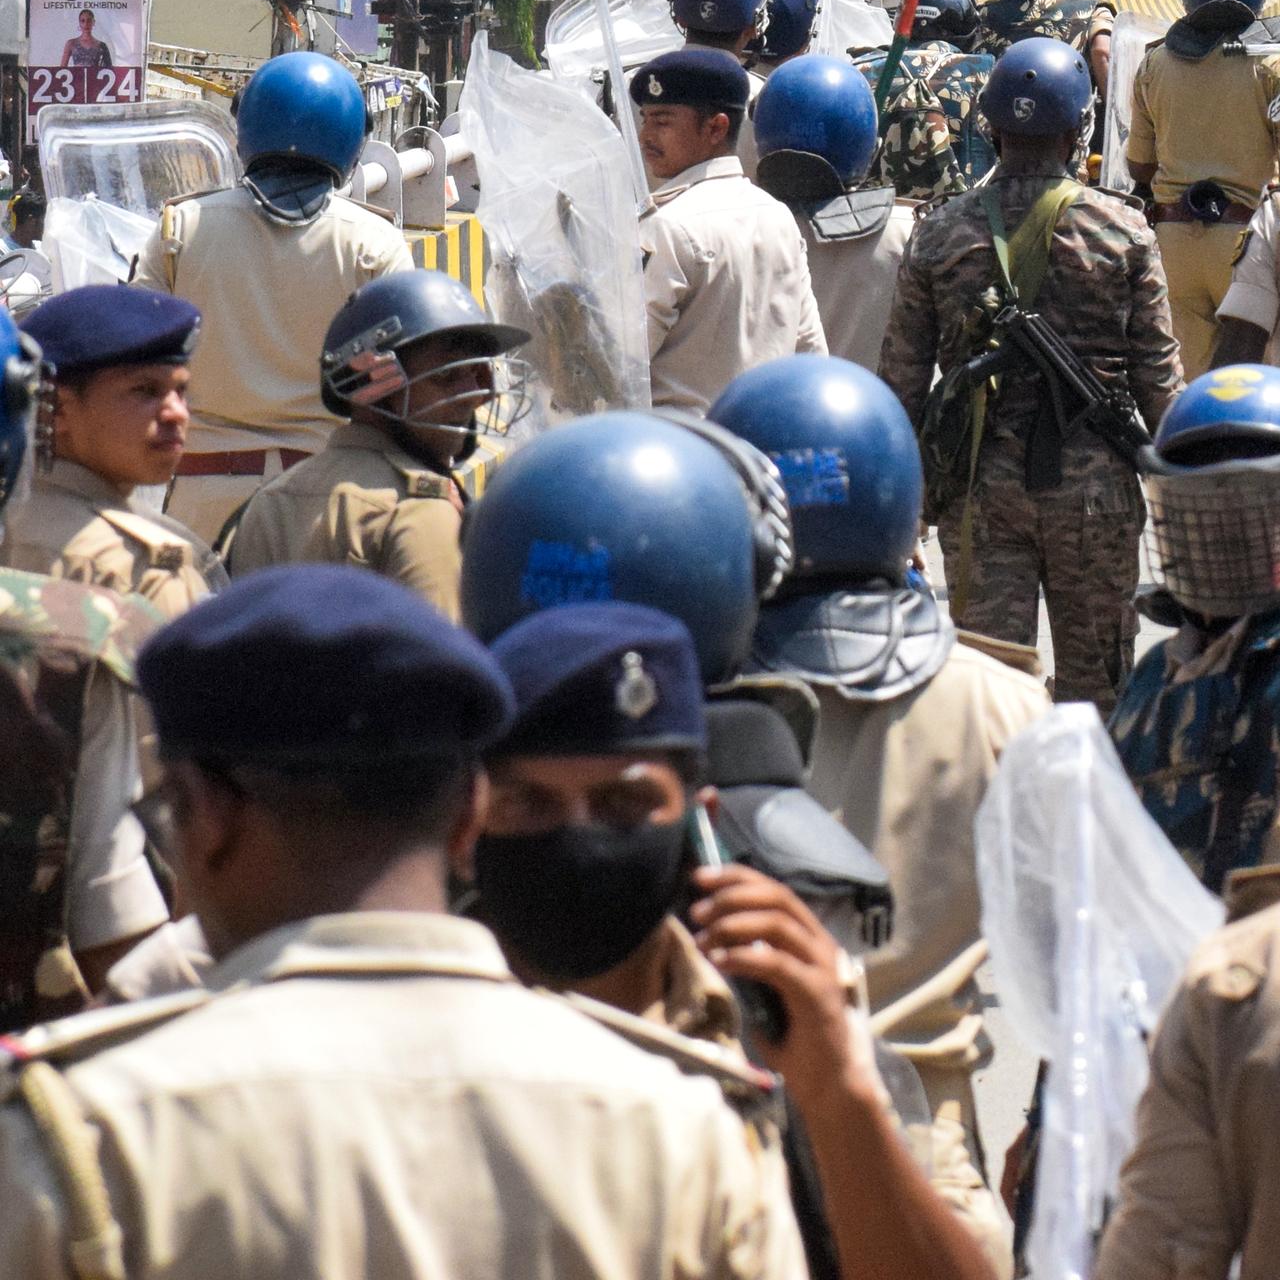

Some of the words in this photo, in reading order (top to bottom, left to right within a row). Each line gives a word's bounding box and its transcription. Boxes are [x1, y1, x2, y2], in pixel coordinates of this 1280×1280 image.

[43, 1, 82, 10] LIFESTYLE
[83, 1, 128, 10] EXHIBITION
[32, 68, 75, 103] 23
[97, 68, 139, 103] 24
